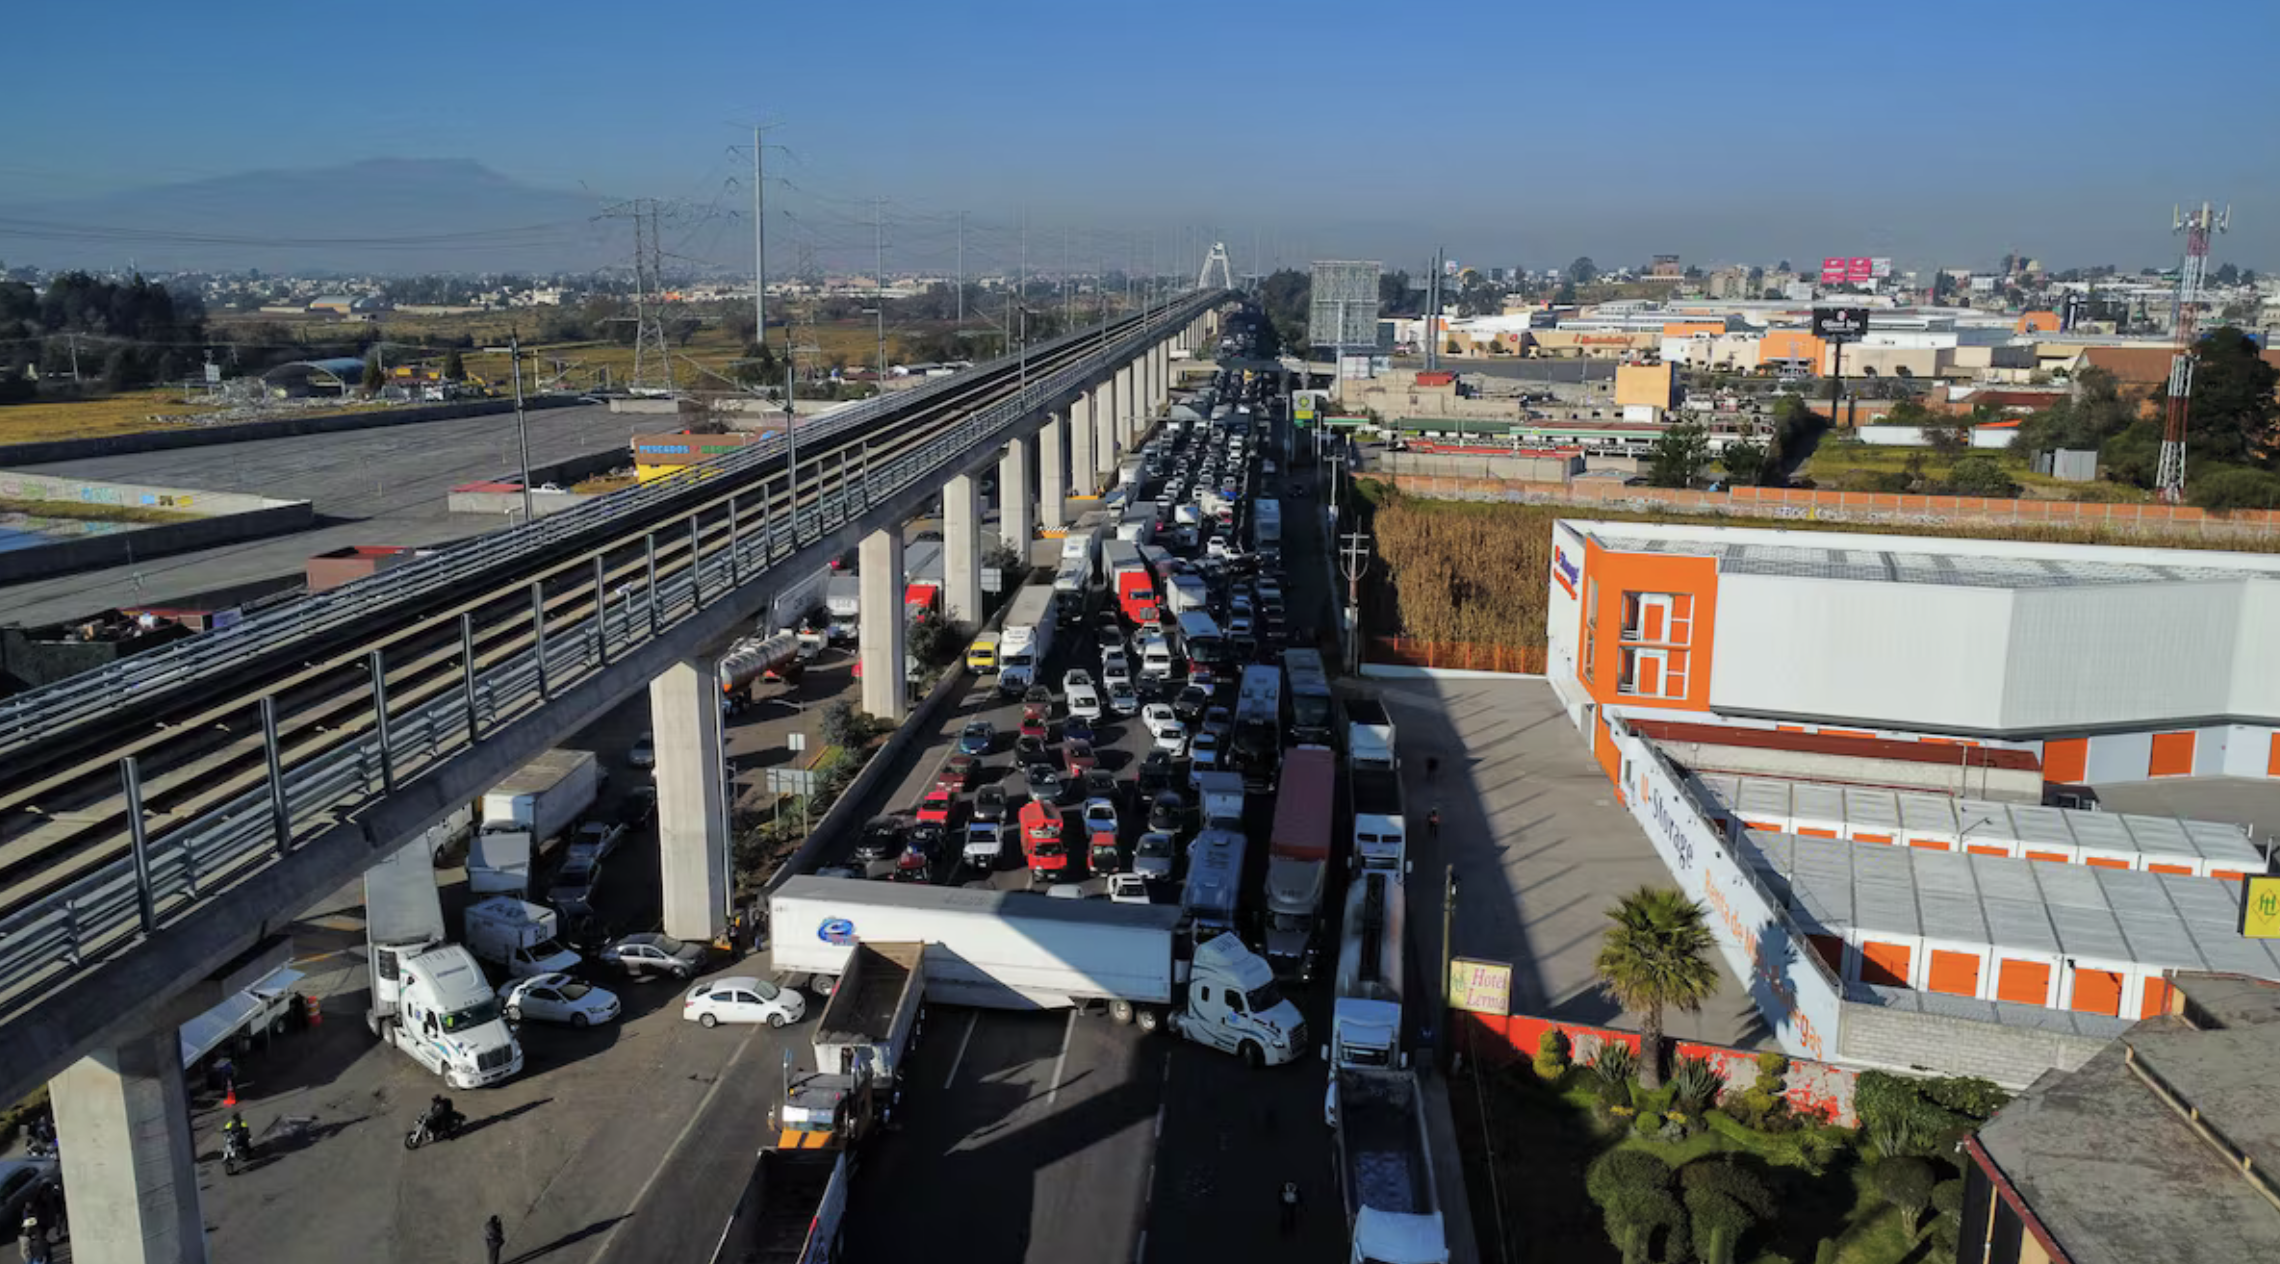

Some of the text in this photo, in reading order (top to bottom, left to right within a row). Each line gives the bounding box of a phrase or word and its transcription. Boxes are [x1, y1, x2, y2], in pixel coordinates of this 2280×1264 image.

[639, 445, 690, 454] PESCADOS
[1640, 772, 1693, 870] U-Storage
[1471, 967, 1508, 989] Hotel
[1466, 988, 1507, 1010] Lerma
